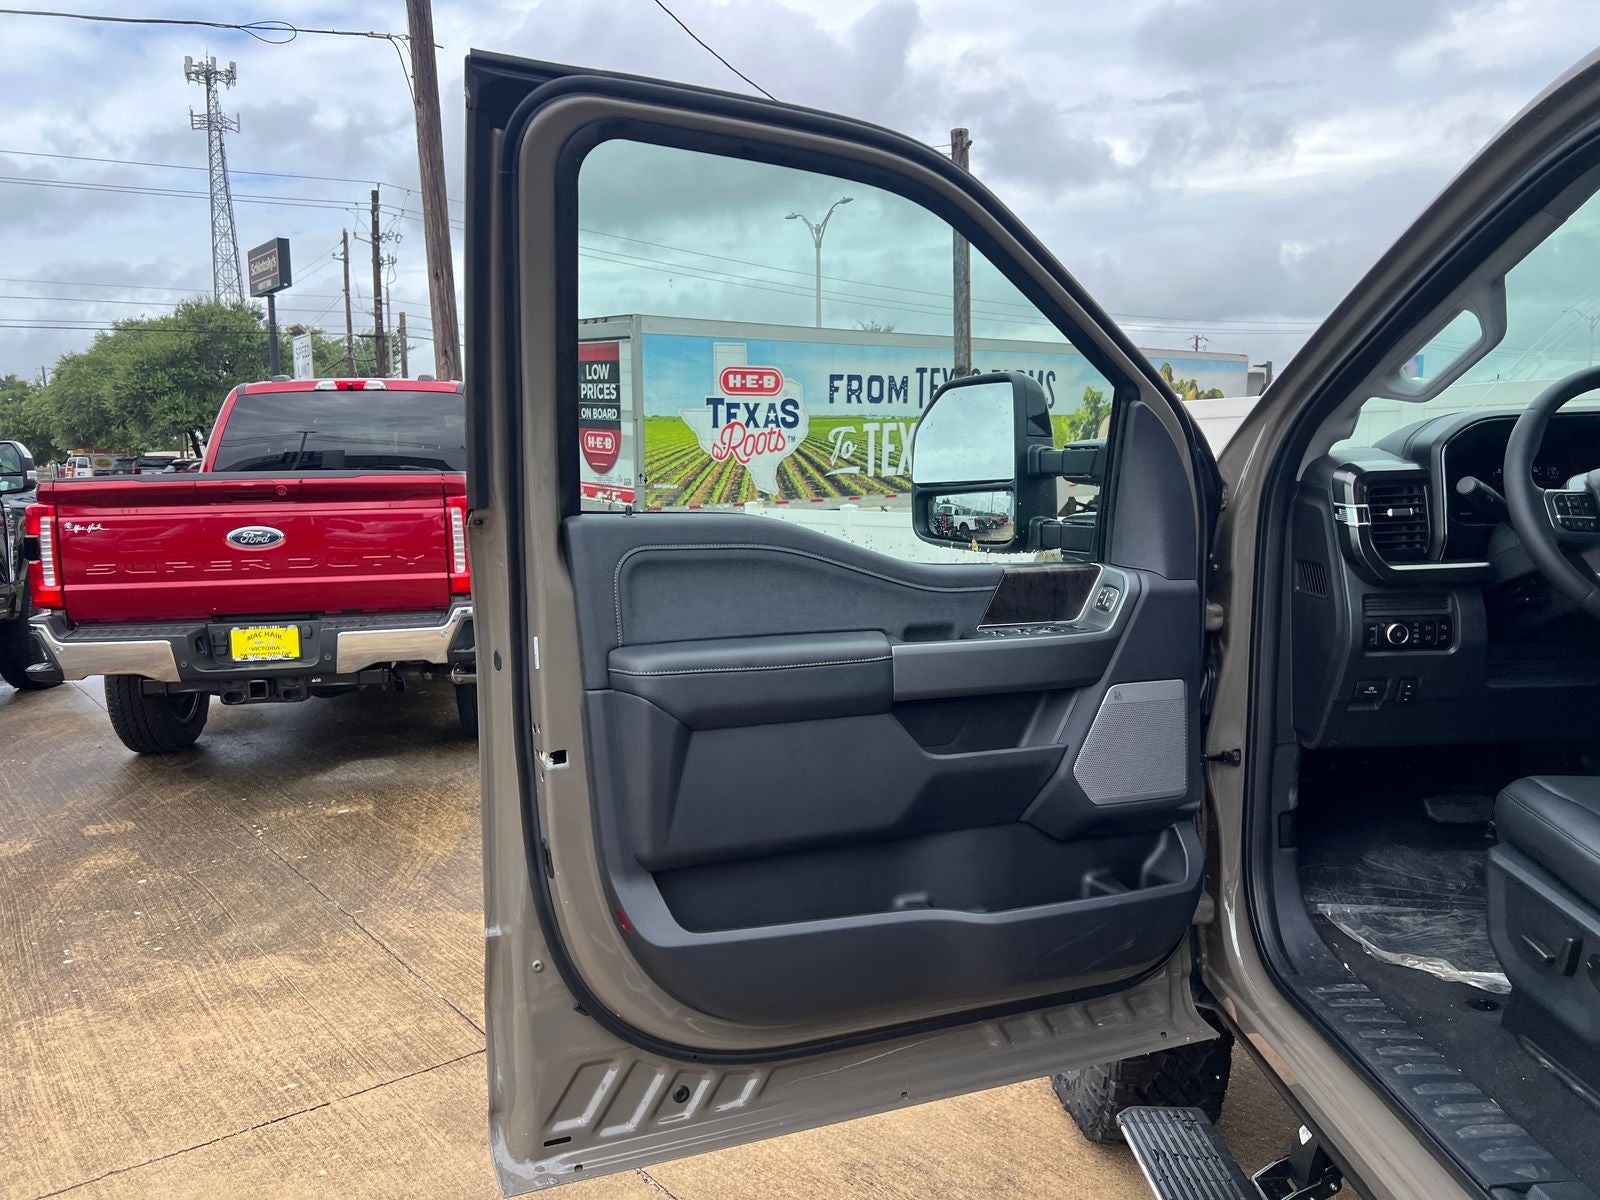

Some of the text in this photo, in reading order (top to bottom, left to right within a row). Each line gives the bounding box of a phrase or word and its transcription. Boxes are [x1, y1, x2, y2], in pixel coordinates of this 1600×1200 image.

[586, 363, 610, 380] LOW
[728, 374, 776, 389] H-E-B
[829, 374, 909, 404] FROM
[580, 383, 617, 400] PRICES
[581, 408, 618, 420] ON BOARD
[706, 397, 800, 429] TEXAS
[712, 421, 786, 464] Roots
[828, 426, 858, 467] To
[240, 531, 271, 544] Ford
[86, 553, 425, 576] SUPER DUTY
[246, 631, 263, 641] MAC
